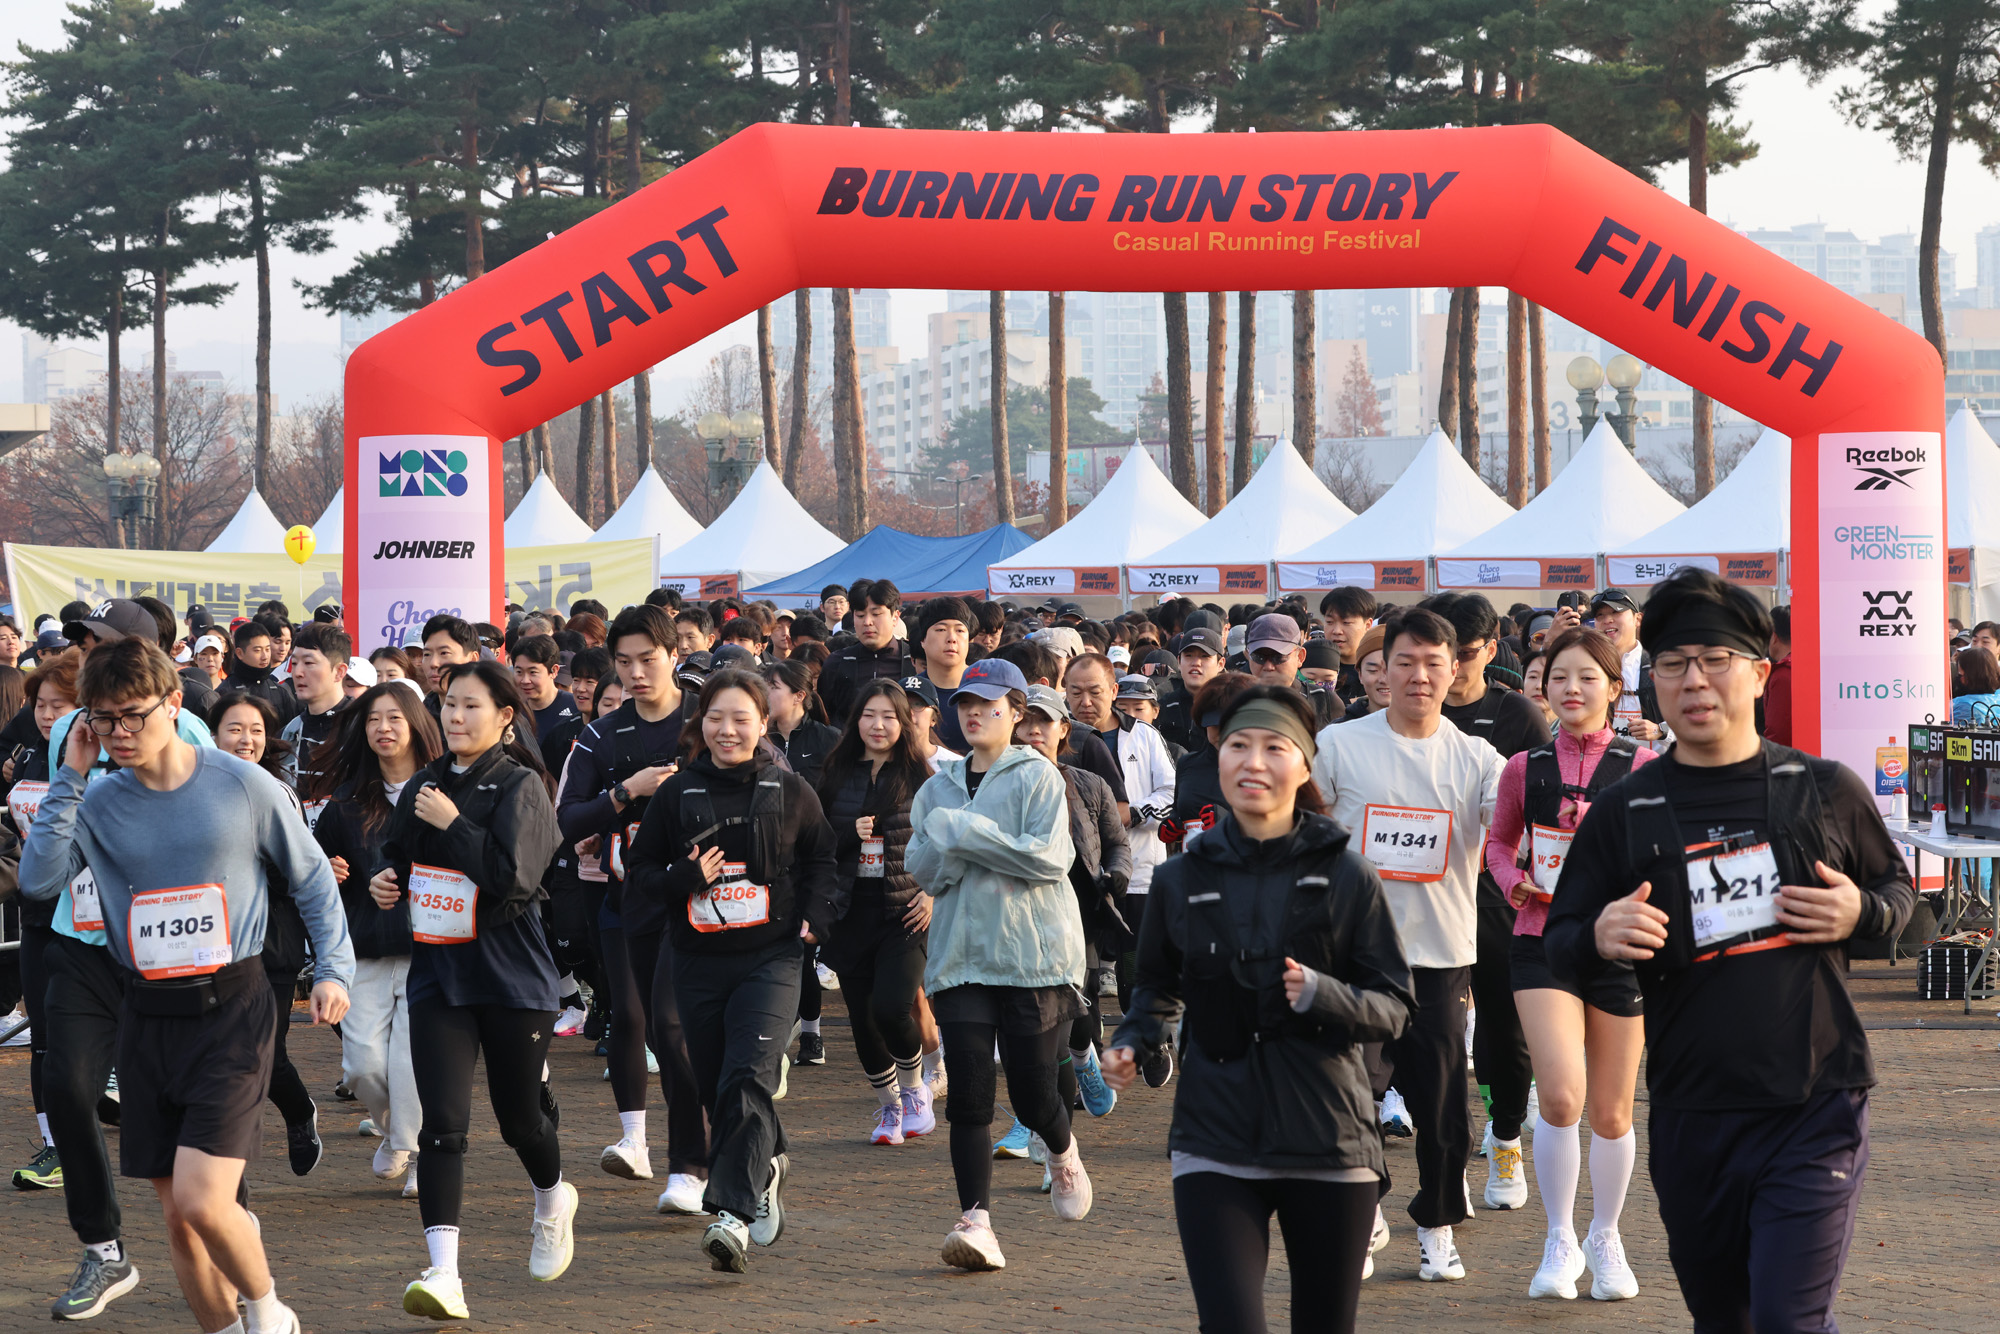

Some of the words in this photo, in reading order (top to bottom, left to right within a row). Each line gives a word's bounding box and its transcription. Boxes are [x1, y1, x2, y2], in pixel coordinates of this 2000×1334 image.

[817, 166, 1100, 222] BURNING
[1107, 174, 1247, 223] RUN
[1250, 170, 1461, 223] STORY
[1113, 230, 1199, 252] Casual
[1208, 231, 1315, 254] Running
[1324, 229, 1421, 250] Festival
[476, 205, 739, 397] START
[1574, 216, 1844, 398] FINISH
[379, 449, 468, 474] MONO
[1846, 447, 1926, 465] Reebok
[1834, 525, 1899, 543] GREEN
[373, 541, 475, 560] JOHNBER
[1850, 542, 1934, 560] MONSTER
[1479, 564, 1499, 573] Choco
[1635, 563, 1666, 578] 온누리
[1745, 570, 1773, 579] STORY
[1026, 576, 1055, 586] REXY
[1168, 575, 1199, 585] REXY
[1859, 623, 1917, 636] REXY
[905, 676, 922, 689] LA
[1951, 740, 1968, 757] 5km
[14, 801, 40, 815] W34
[1414, 813, 1436, 821] STORY
[162, 895, 178, 904] RUN
[178, 892, 205, 902] STORY
